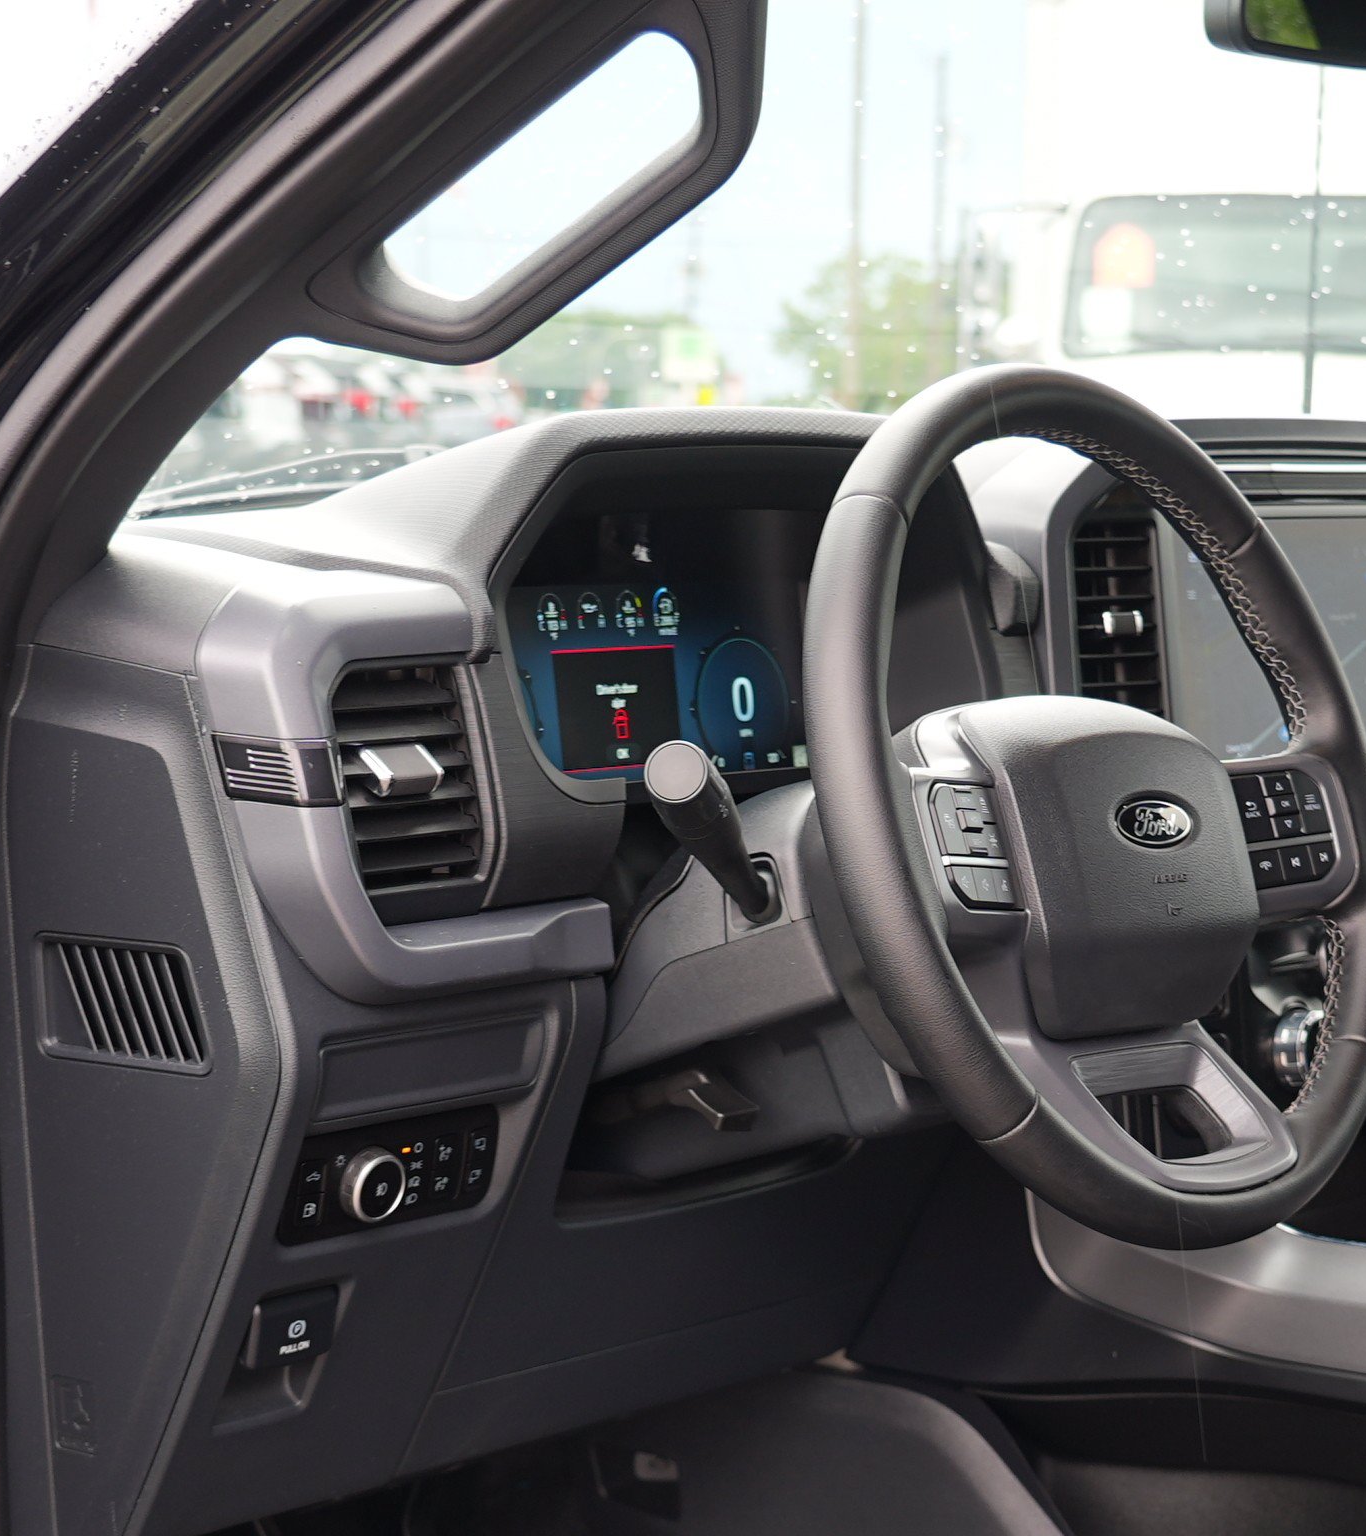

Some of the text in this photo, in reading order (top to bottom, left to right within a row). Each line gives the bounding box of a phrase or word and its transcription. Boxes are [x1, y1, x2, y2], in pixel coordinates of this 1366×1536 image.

[731, 676, 755, 722] 0
[1134, 806, 1180, 837] Ford
[279, 1344, 298, 1355] PULL
